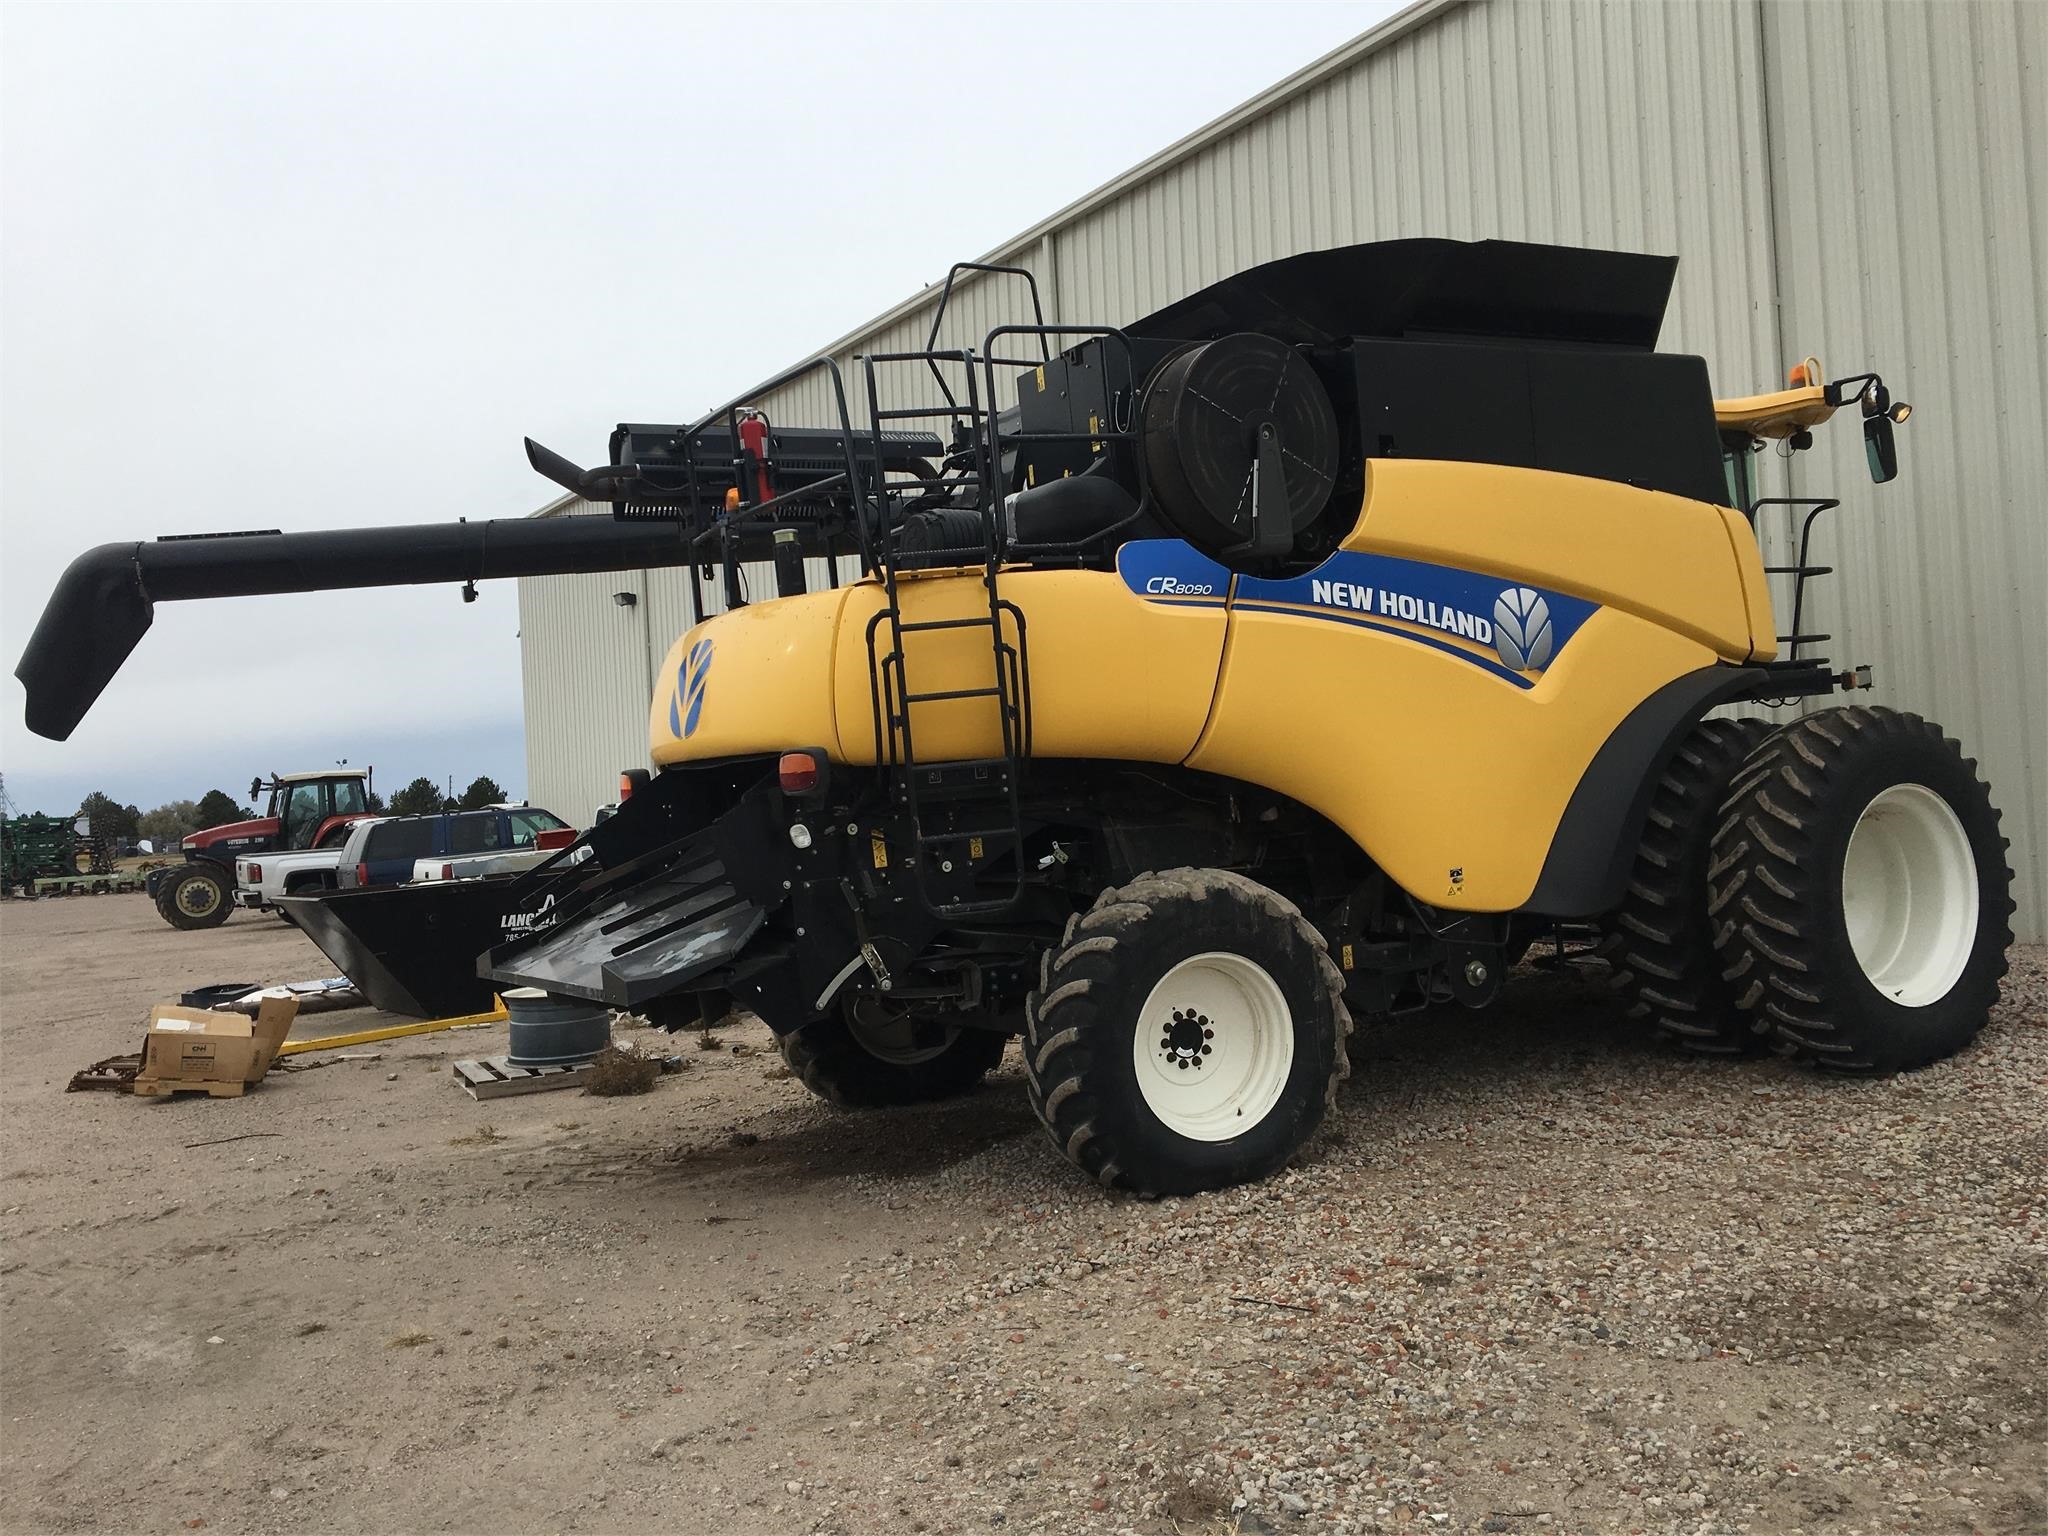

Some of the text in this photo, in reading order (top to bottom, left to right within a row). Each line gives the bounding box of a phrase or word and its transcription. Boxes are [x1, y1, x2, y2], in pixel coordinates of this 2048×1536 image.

[1146, 577, 1212, 595] CR8090
[1312, 579, 1493, 644] NEW HOLLAND
